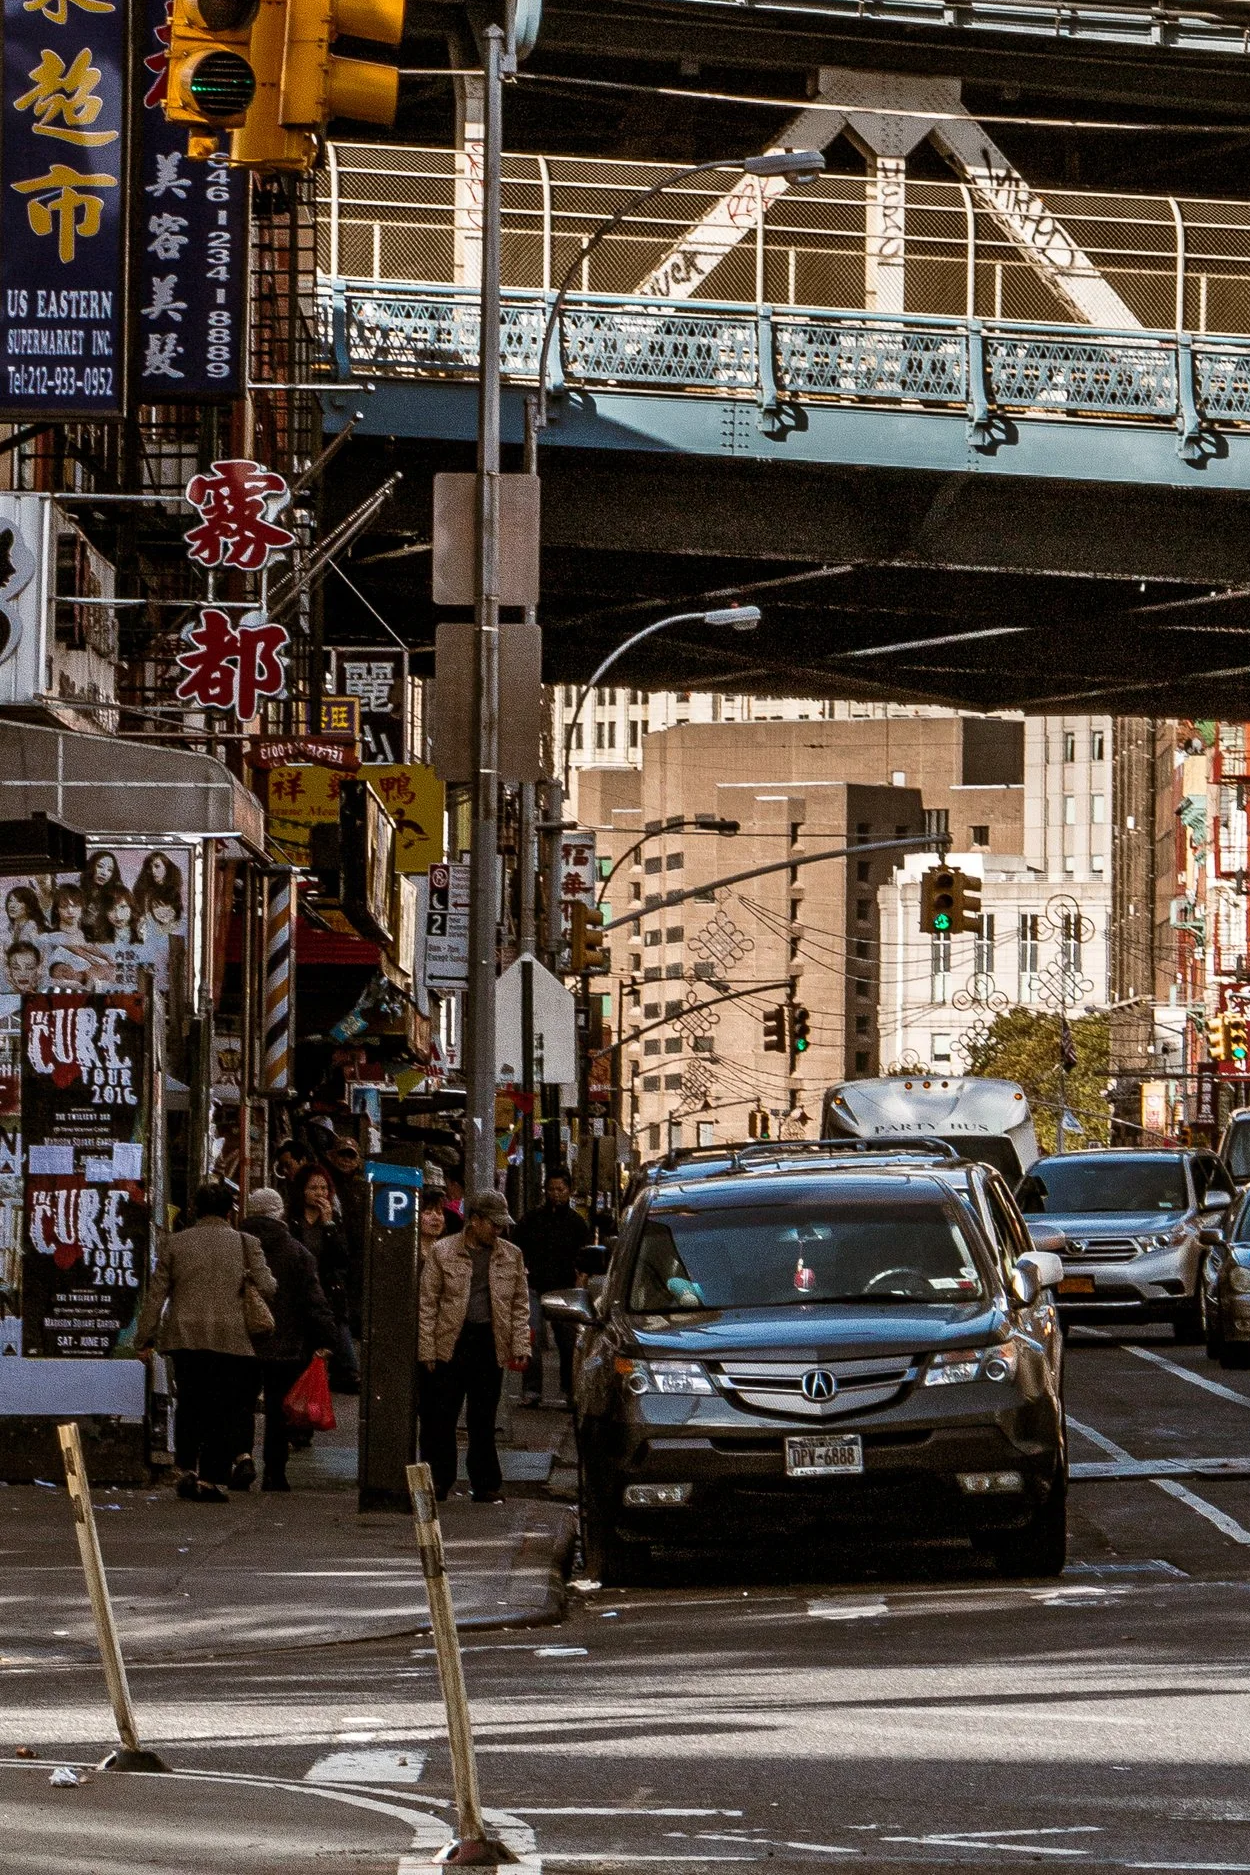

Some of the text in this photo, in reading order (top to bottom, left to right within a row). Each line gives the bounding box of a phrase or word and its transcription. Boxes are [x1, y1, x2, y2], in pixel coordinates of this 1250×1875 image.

[6, 289, 113, 319] US EASTERN
[7, 328, 113, 356] SUPERMARKET INC.
[27, 1008, 132, 1074] THE CURE
[80, 1066, 132, 1086] TOUR
[91, 1086, 138, 1106] 2016
[29, 1189, 134, 1254] THE CURE
[388, 1192, 408, 1223] P
[83, 1248, 133, 1267] TOUR
[92, 1268, 139, 1287] 2016
